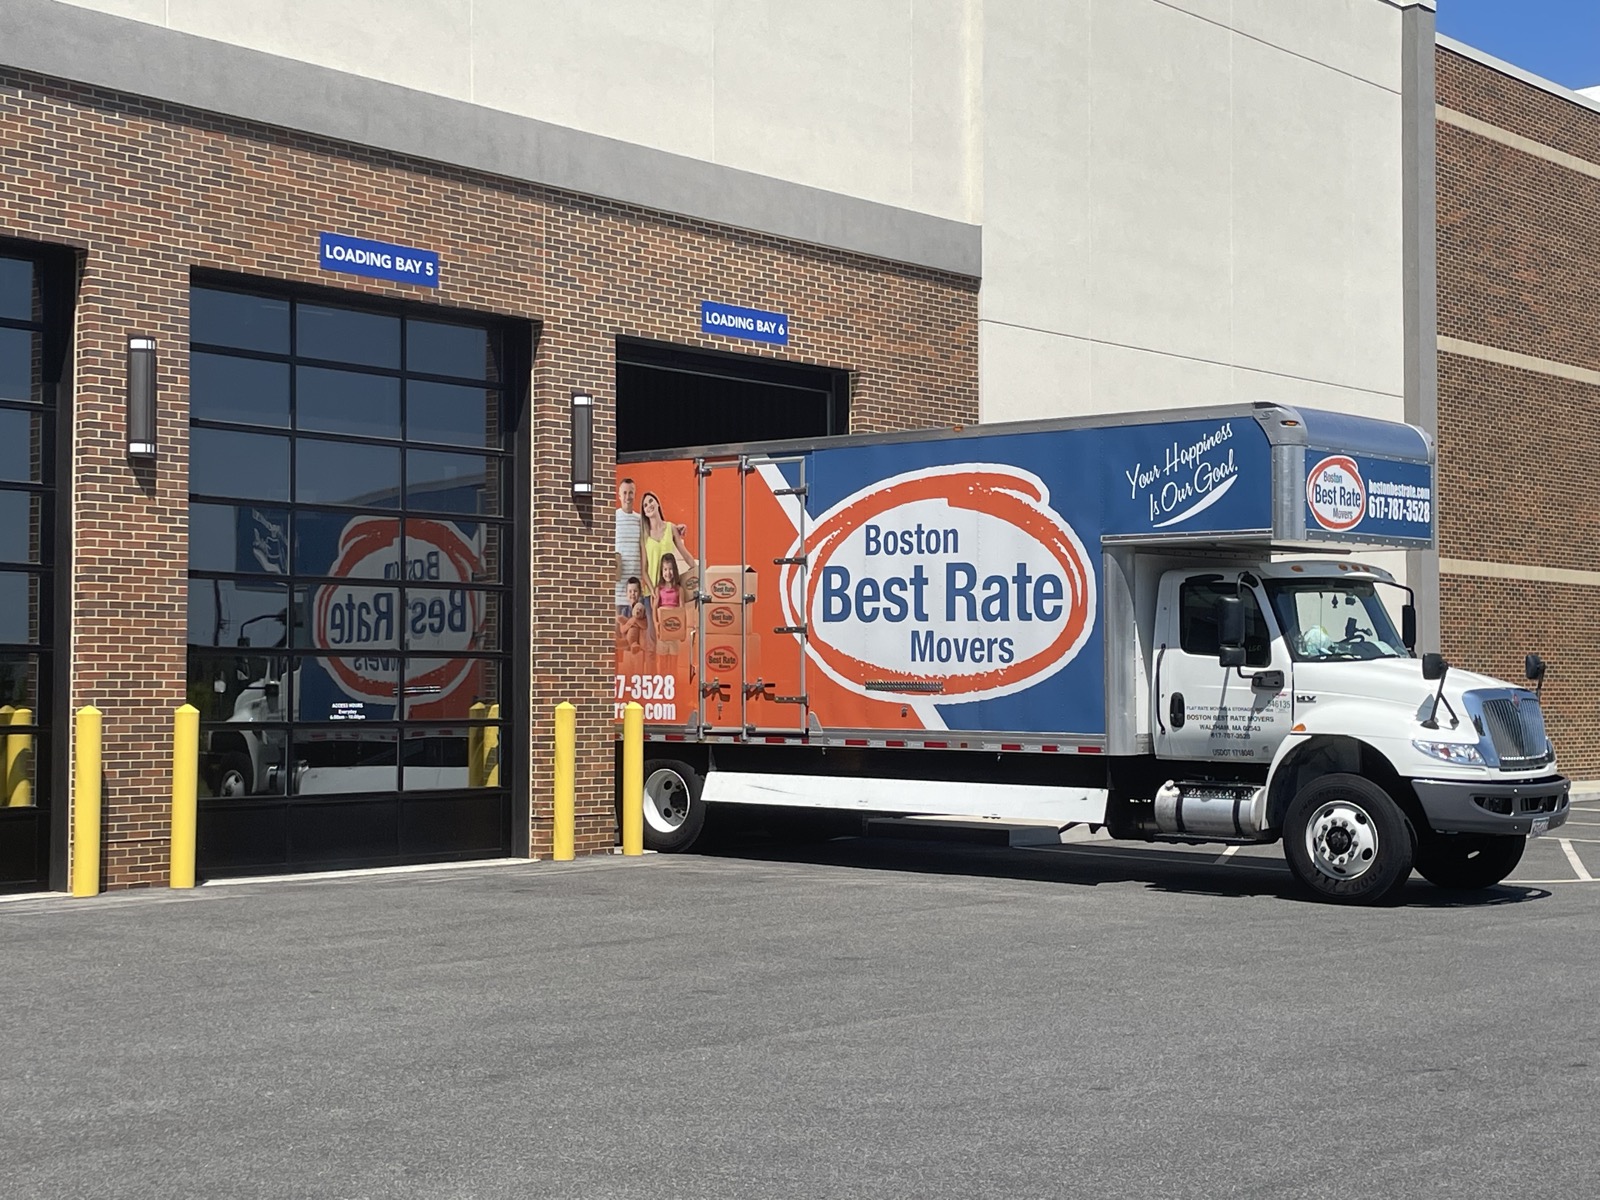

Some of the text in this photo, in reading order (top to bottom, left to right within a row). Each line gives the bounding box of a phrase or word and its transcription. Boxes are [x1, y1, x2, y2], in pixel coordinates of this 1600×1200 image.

[325, 244, 434, 276] LOADING BAY 5
[705, 311, 785, 335] LOADING BAY 6
[1125, 422, 1233, 499] Your Happiness
[1149, 448, 1238, 521] Is Our Goal.
[1323, 471, 1342, 484] Boston
[1315, 484, 1361, 508] Best Rate
[1368, 495, 1430, 523] 617-787-3528
[1332, 507, 1353, 520] Movers
[865, 523, 959, 556] Boston
[822, 562, 1064, 623] Best Rate
[910, 630, 1014, 663] Movers
[614, 674, 676, 700] 7-3528
[1212, 748, 1231, 757] USDOT
